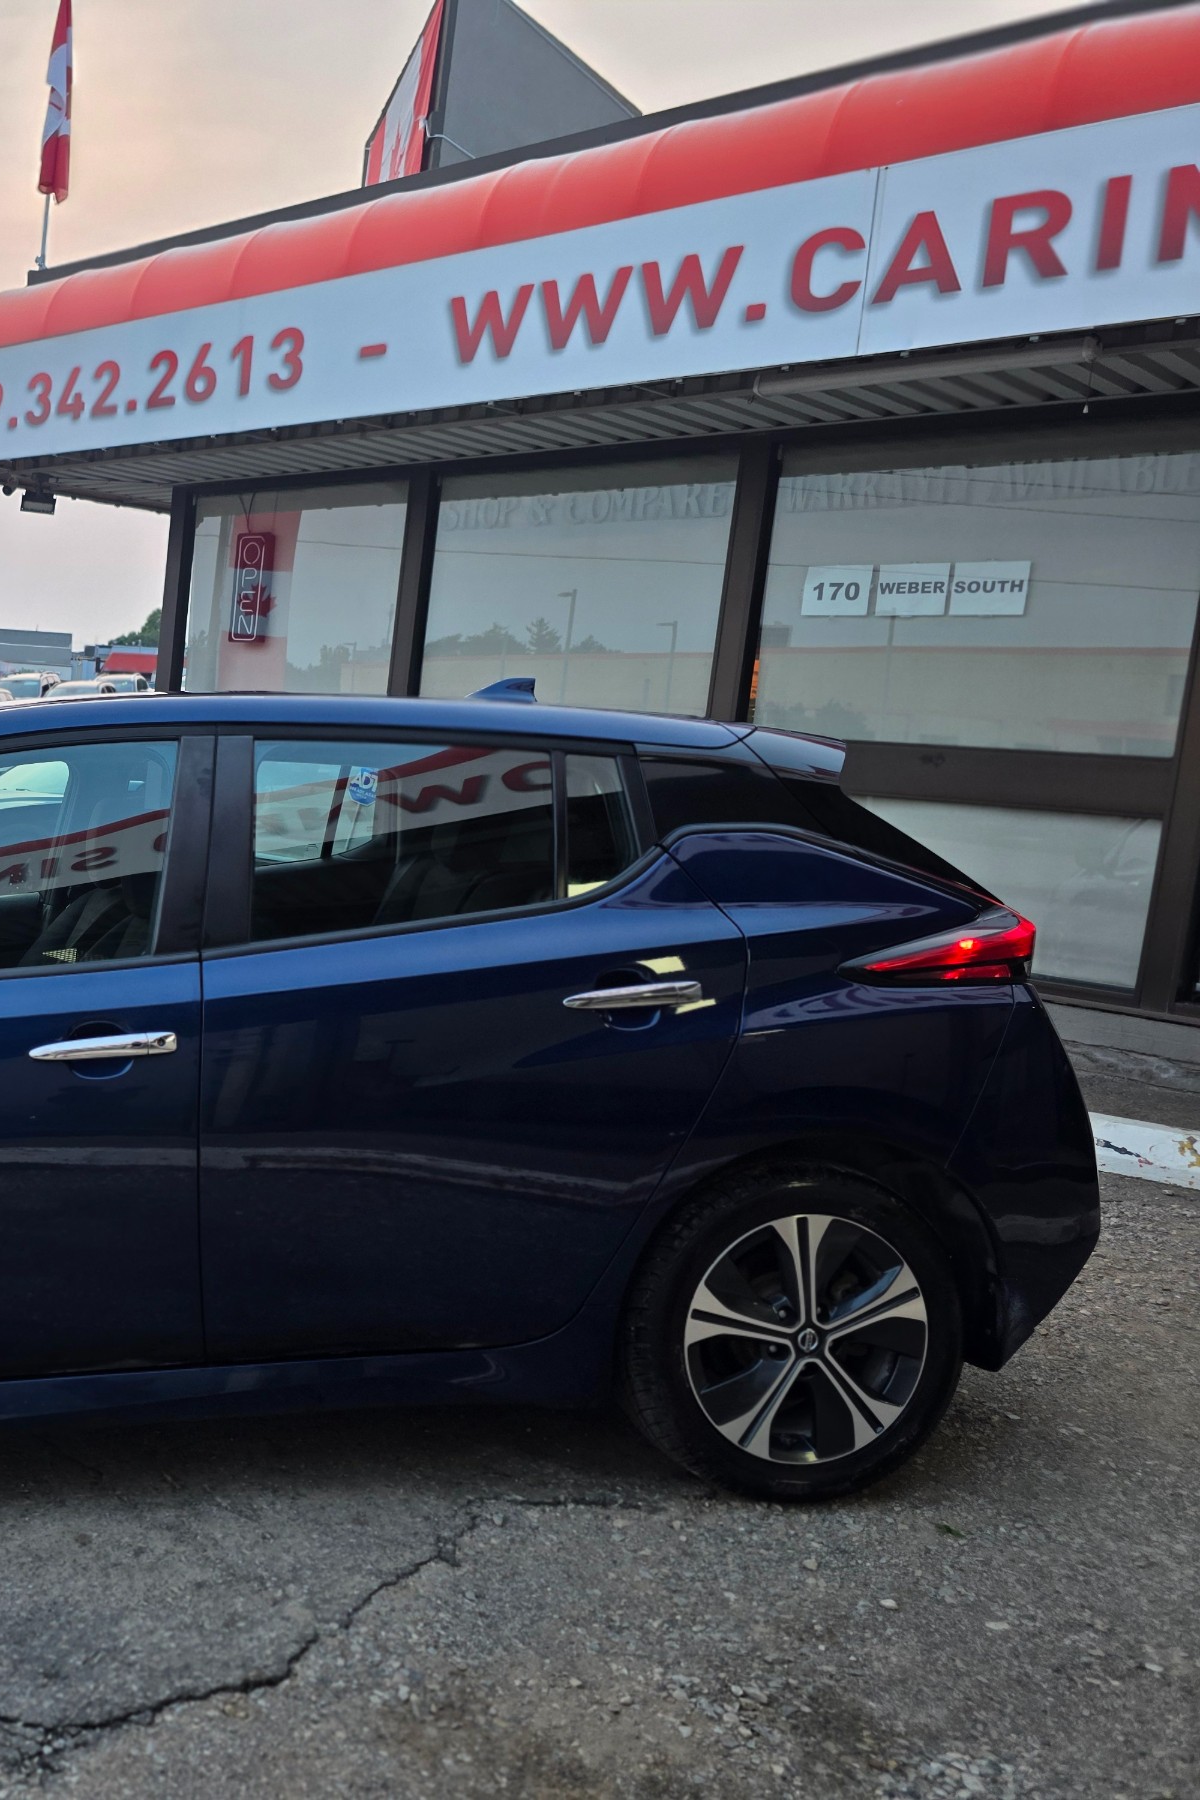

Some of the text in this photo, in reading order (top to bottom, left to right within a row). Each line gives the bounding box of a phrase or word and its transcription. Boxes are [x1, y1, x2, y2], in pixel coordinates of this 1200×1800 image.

[237, 542, 260, 635] OPEN
[812, 579, 1025, 601] 170 WEBER SOUTH
